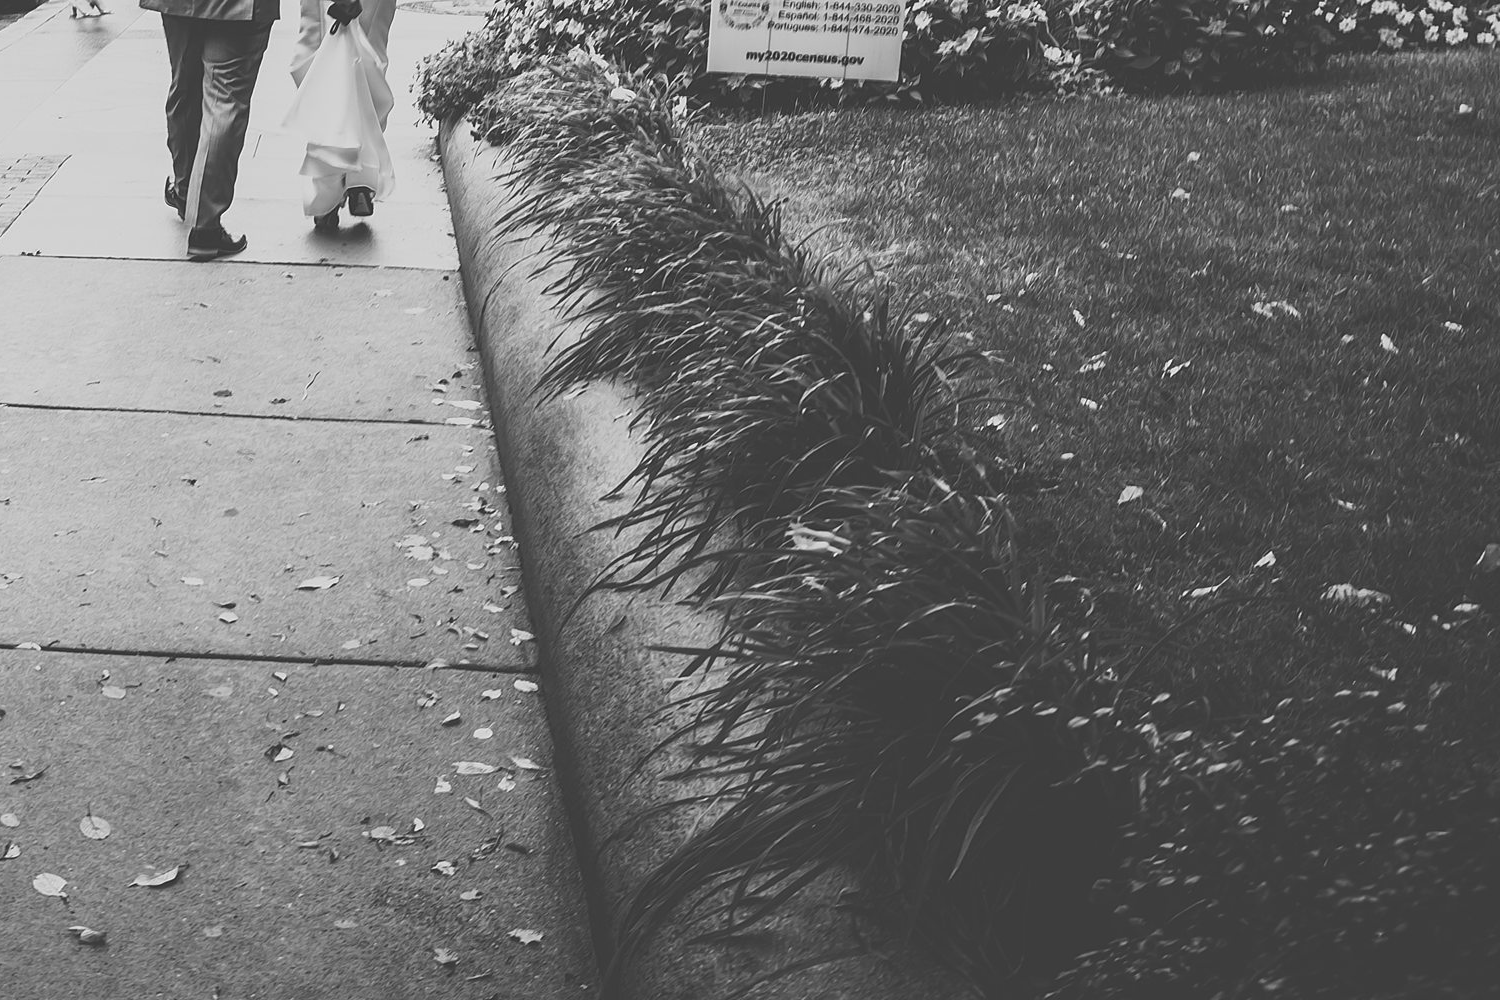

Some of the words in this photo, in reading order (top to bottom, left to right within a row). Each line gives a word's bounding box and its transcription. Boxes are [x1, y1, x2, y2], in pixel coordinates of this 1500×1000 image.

[782, 0, 820, 12] English:
[824, 1, 901, 15] 1-844-330-2020
[822, 23, 899, 37] 1-844-474-2020
[745, 50, 865, 67] my2020census.gov
